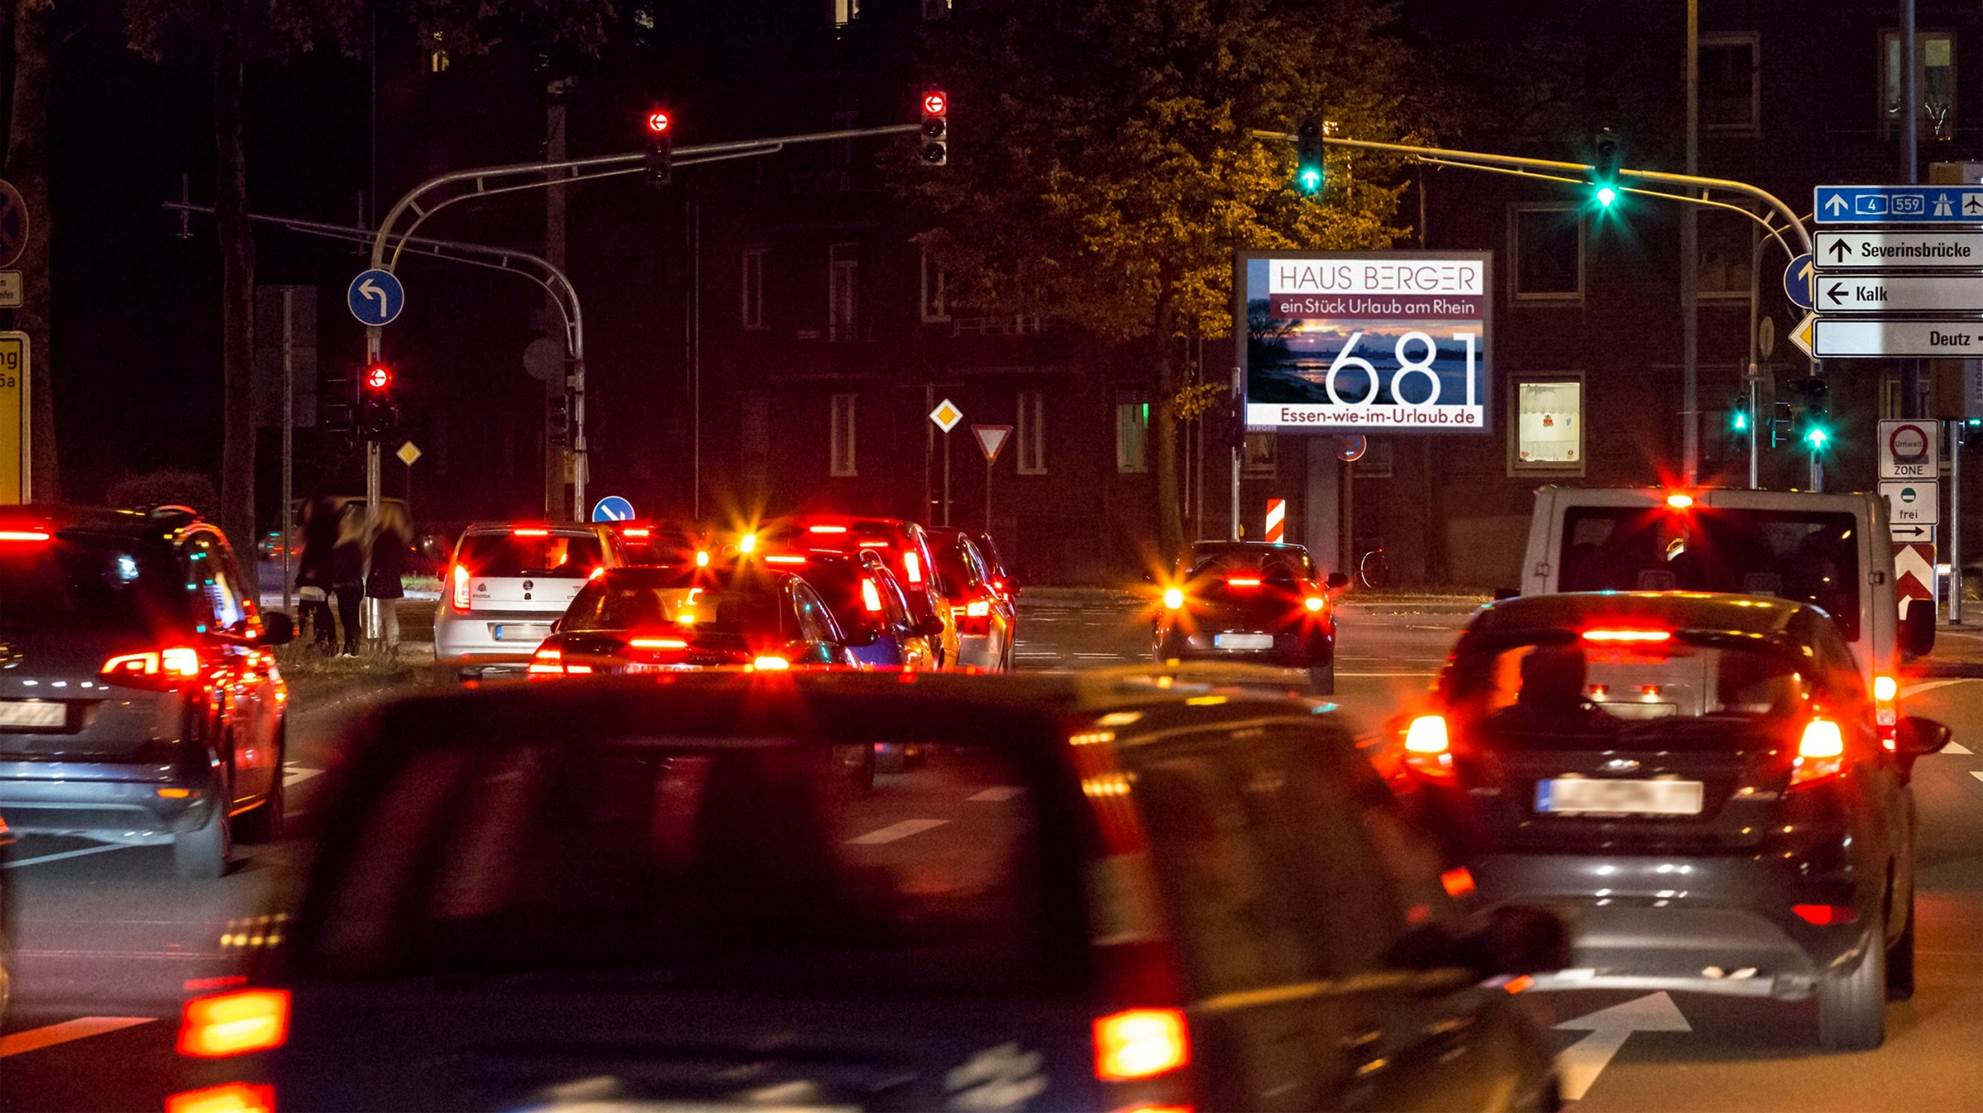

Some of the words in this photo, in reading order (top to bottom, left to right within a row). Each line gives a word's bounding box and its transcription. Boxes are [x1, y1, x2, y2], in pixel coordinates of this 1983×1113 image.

[1868, 199, 1876, 211] 4
[1896, 199, 1920, 210] 559
[1861, 242, 1971, 258] Severinsbrücke
[1280, 266, 1352, 290] HAUS
[1364, 266, 1475, 290] BERGER
[1856, 286, 1888, 301] Kalk
[1280, 301, 1304, 314] ein
[1306, 298, 1346, 314] Stück
[1349, 299, 1402, 314] Urlaub
[1405, 302, 1431, 314] am
[1434, 299, 1475, 314] Rhein
[1930, 331, 1971, 346] Deutz
[1325, 331, 1476, 406] 681
[1281, 408, 1475, 424] Essen-wie-im-Urlaub.de
[1894, 465, 1923, 475] ZONE
[1899, 509, 1918, 519] frei
